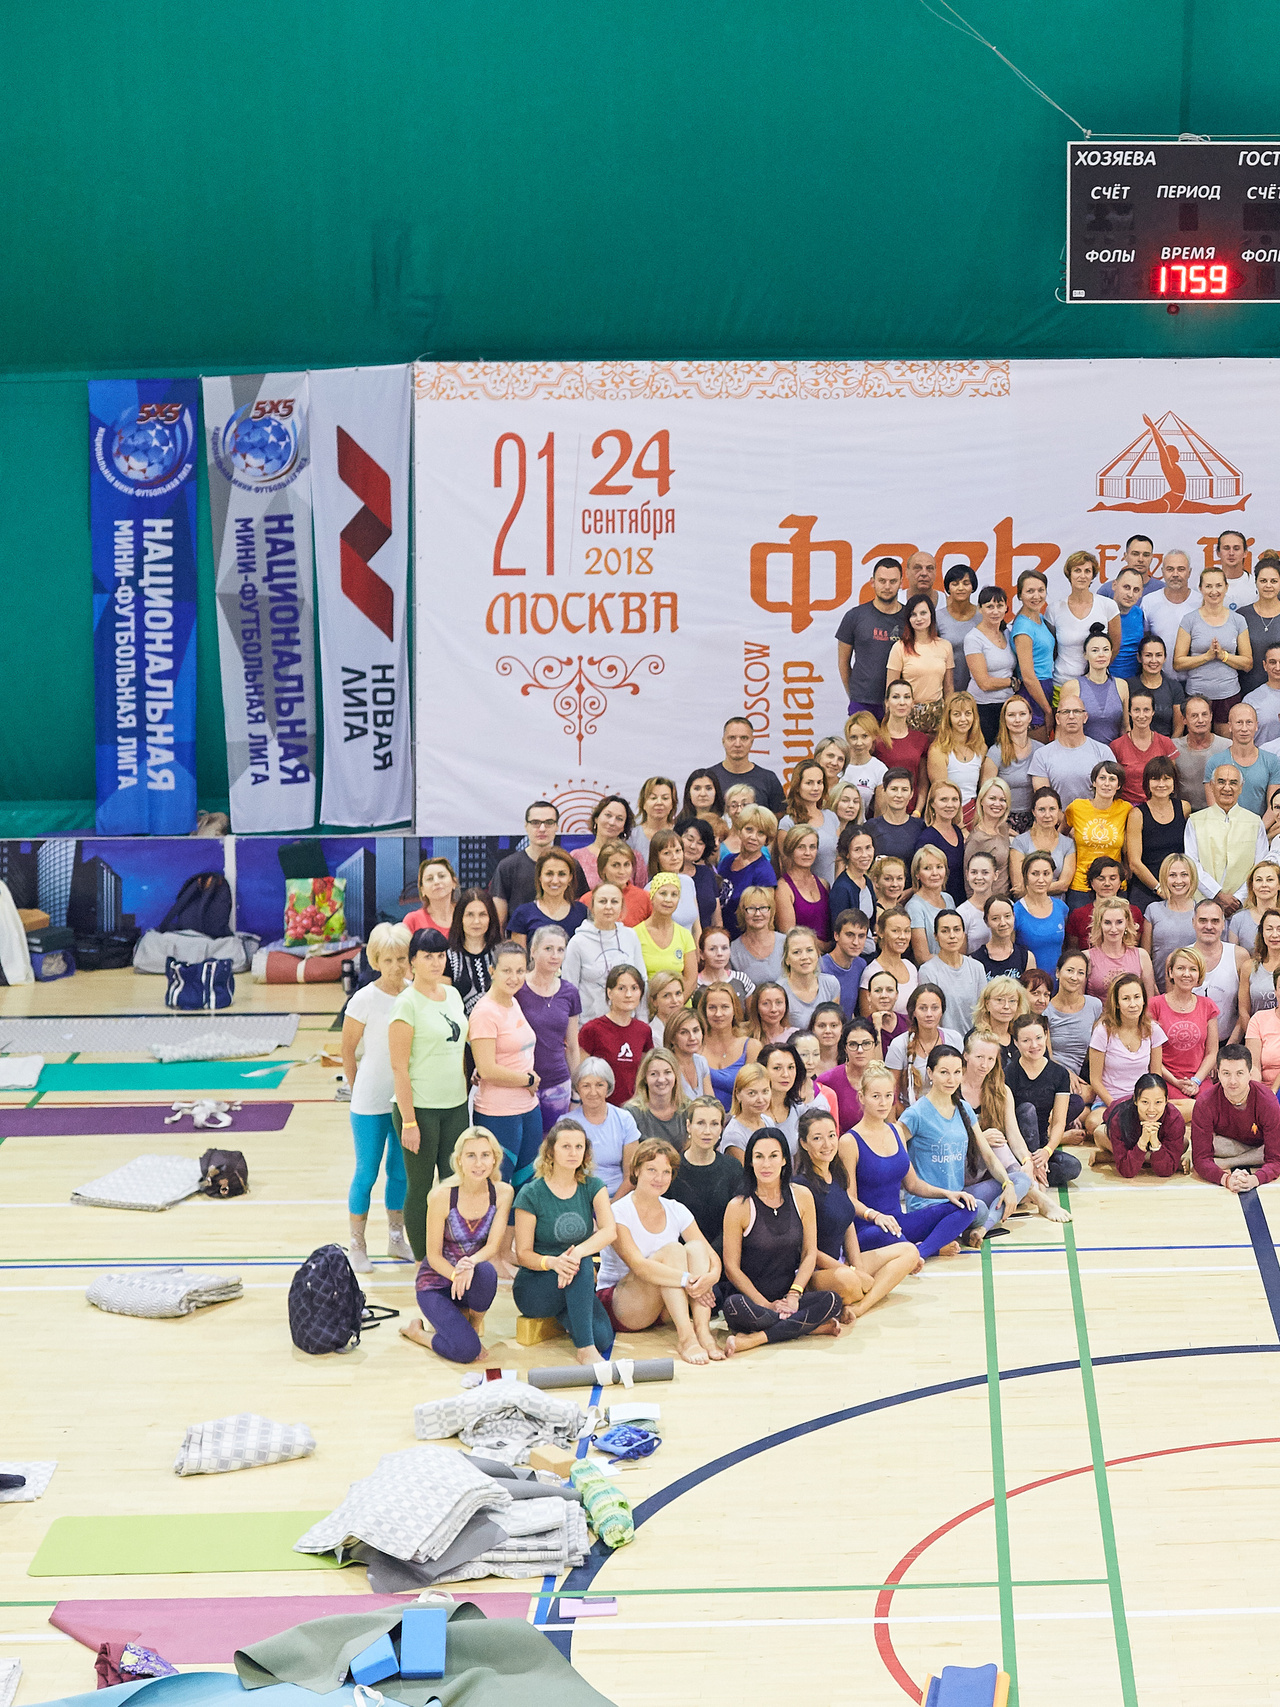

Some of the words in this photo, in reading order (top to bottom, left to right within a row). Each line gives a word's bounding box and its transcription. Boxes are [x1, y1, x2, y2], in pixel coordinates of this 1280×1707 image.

[1075, 151, 1157, 166] ХОЗЯЕВА
[1091, 183, 1130, 199] СЧЁТ
[1156, 185, 1221, 200] ПЕРИОД
[1085, 249, 1135, 263] ФОЛЫ
[1159, 265, 1228, 294] 1759
[1160, 247, 1216, 260] ВРЕМЯ
[588, 428, 676, 497] 24
[492, 431, 555, 576] 21
[581, 500, 675, 540] сентября
[584, 547, 654, 575] 2018
[114, 520, 135, 729] МИНИ-ФУТБОЛЬНАЯ
[234, 518, 265, 725] МИНИ-ФУТБОЛЬНАЯ
[485, 591, 679, 634] МОСКВА
[140, 518, 175, 791] НАЦИОНАЛЬНАЯ
[263, 513, 310, 786] НАЦИОНАЛЬНАЯ
[341, 665, 368, 743] ЛИГА
[371, 664, 394, 772] НОВАЯ
[117, 735, 138, 790] ЛИГА
[249, 732, 270, 786] ЛИГА
